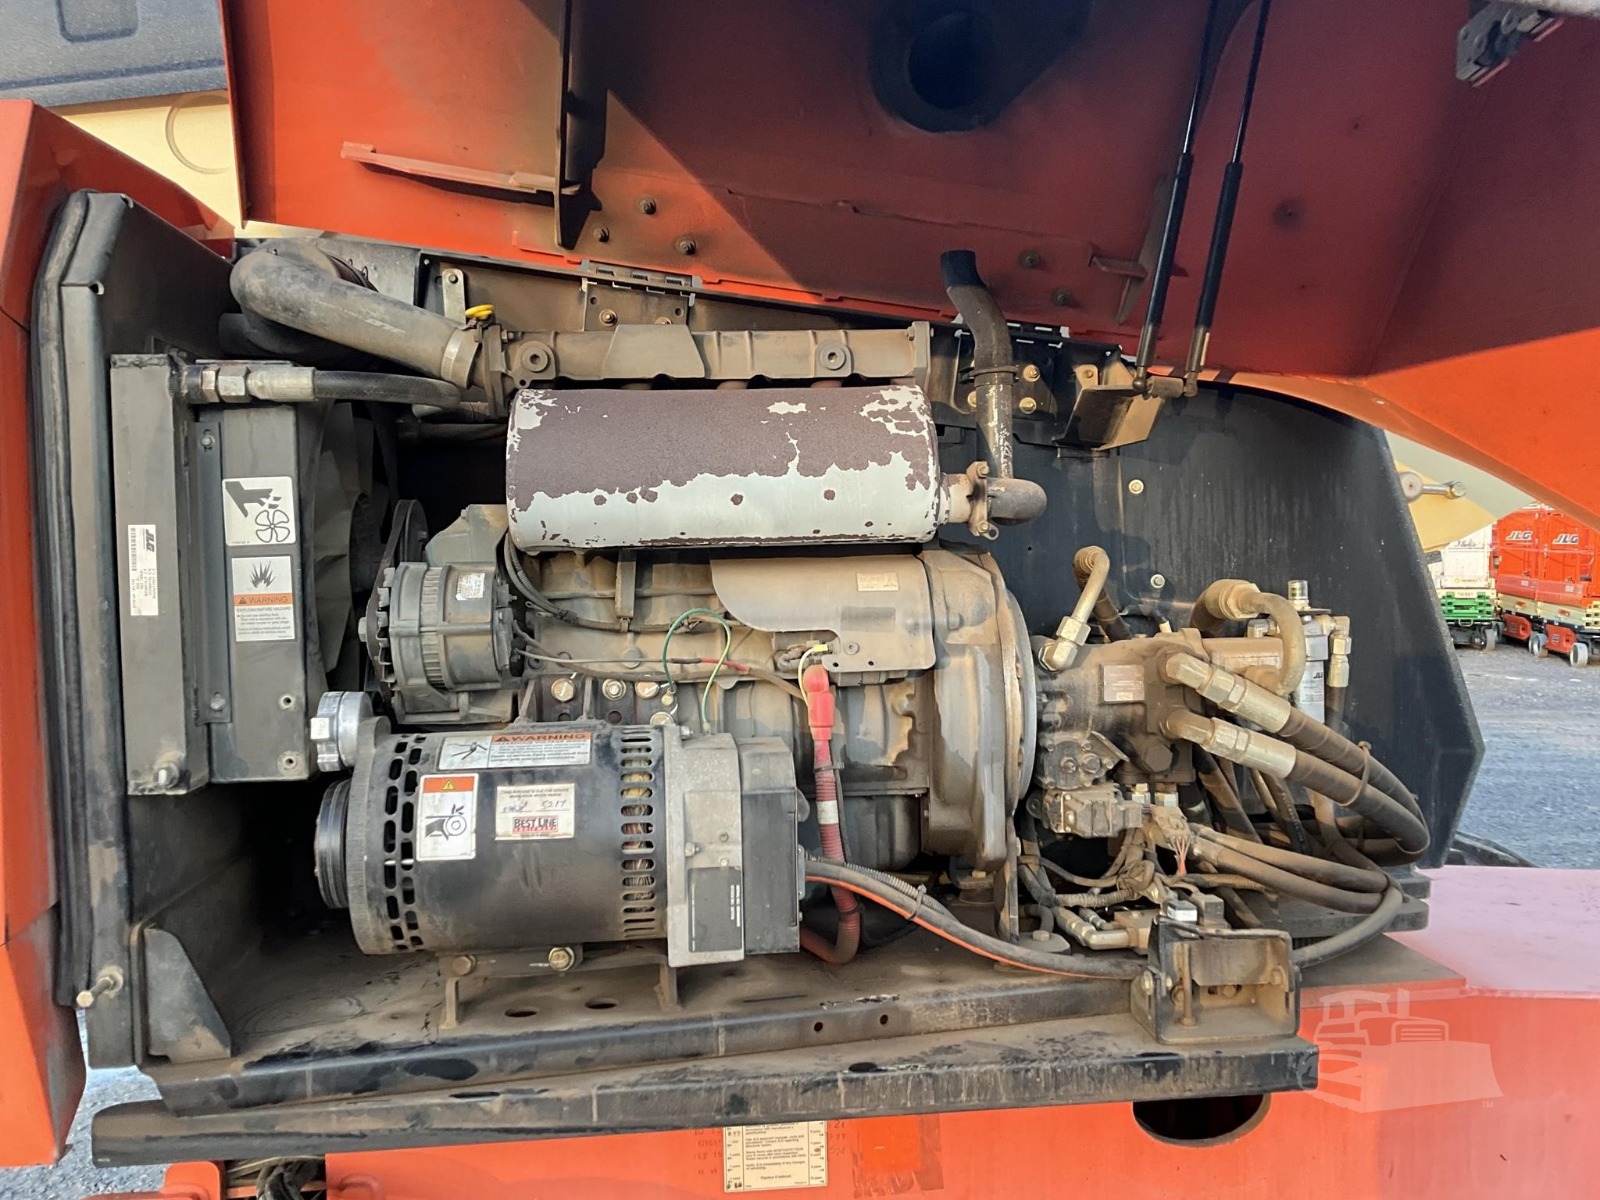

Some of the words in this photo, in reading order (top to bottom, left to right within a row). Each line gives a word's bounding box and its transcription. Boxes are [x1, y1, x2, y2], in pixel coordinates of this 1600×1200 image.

[1506, 531, 1533, 540] JLG
[1552, 534, 1579, 544] JLG
[145, 529, 155, 552] JLG
[249, 595, 288, 604] WARNING
[511, 733, 586, 741] WARNING
[514, 818, 536, 828] BEST
[538, 817, 557, 828] LINE
